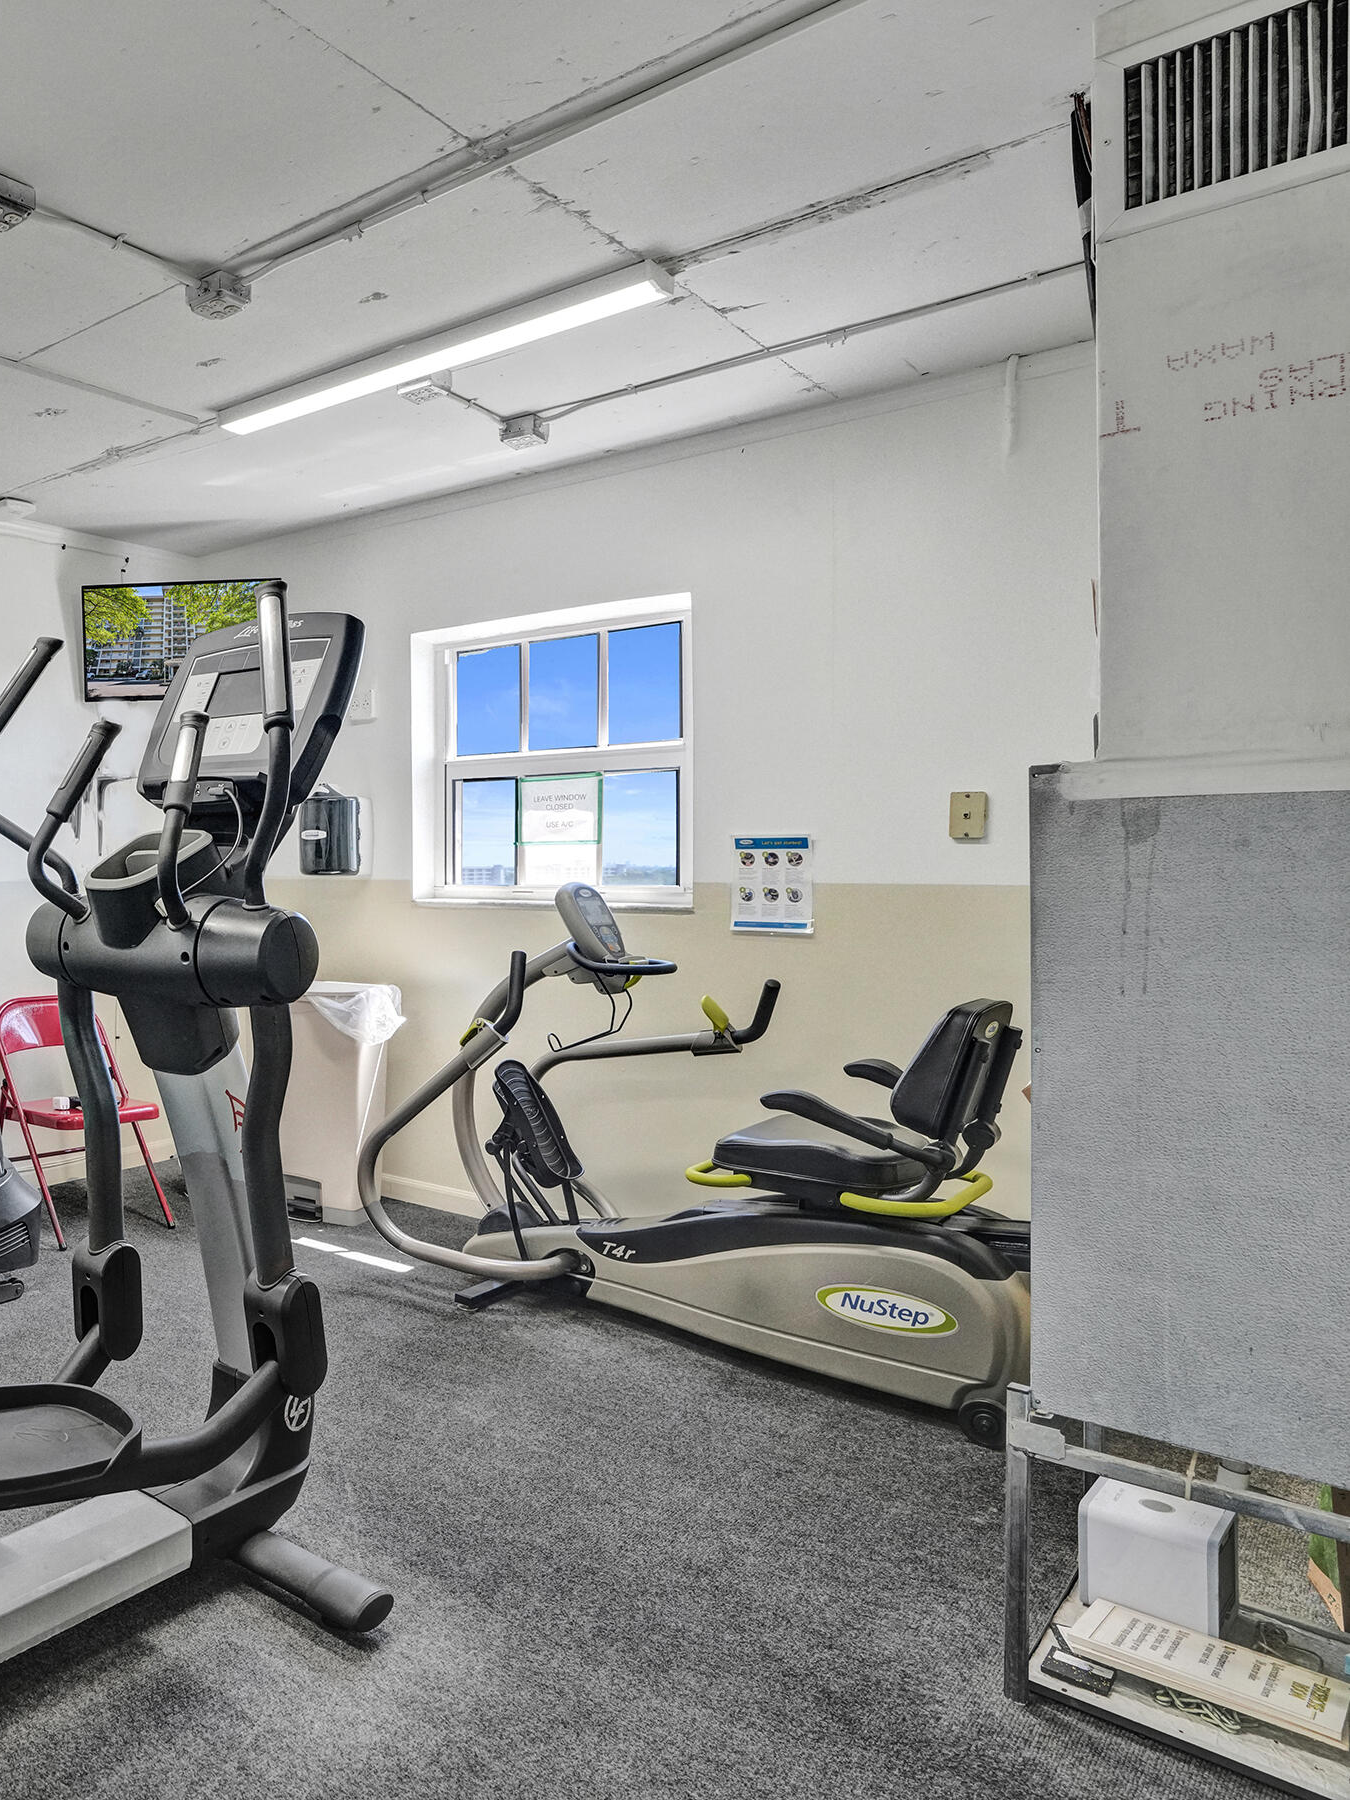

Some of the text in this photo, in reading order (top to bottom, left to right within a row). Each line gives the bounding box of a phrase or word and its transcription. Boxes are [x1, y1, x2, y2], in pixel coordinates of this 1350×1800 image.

[533, 793, 587, 803] LEAVE WINDOW
[545, 803, 574, 811] CLOSED
[561, 820, 574, 828] A/C
[601, 1240, 637, 1260] T4r
[840, 1292, 930, 1328] NuStep
